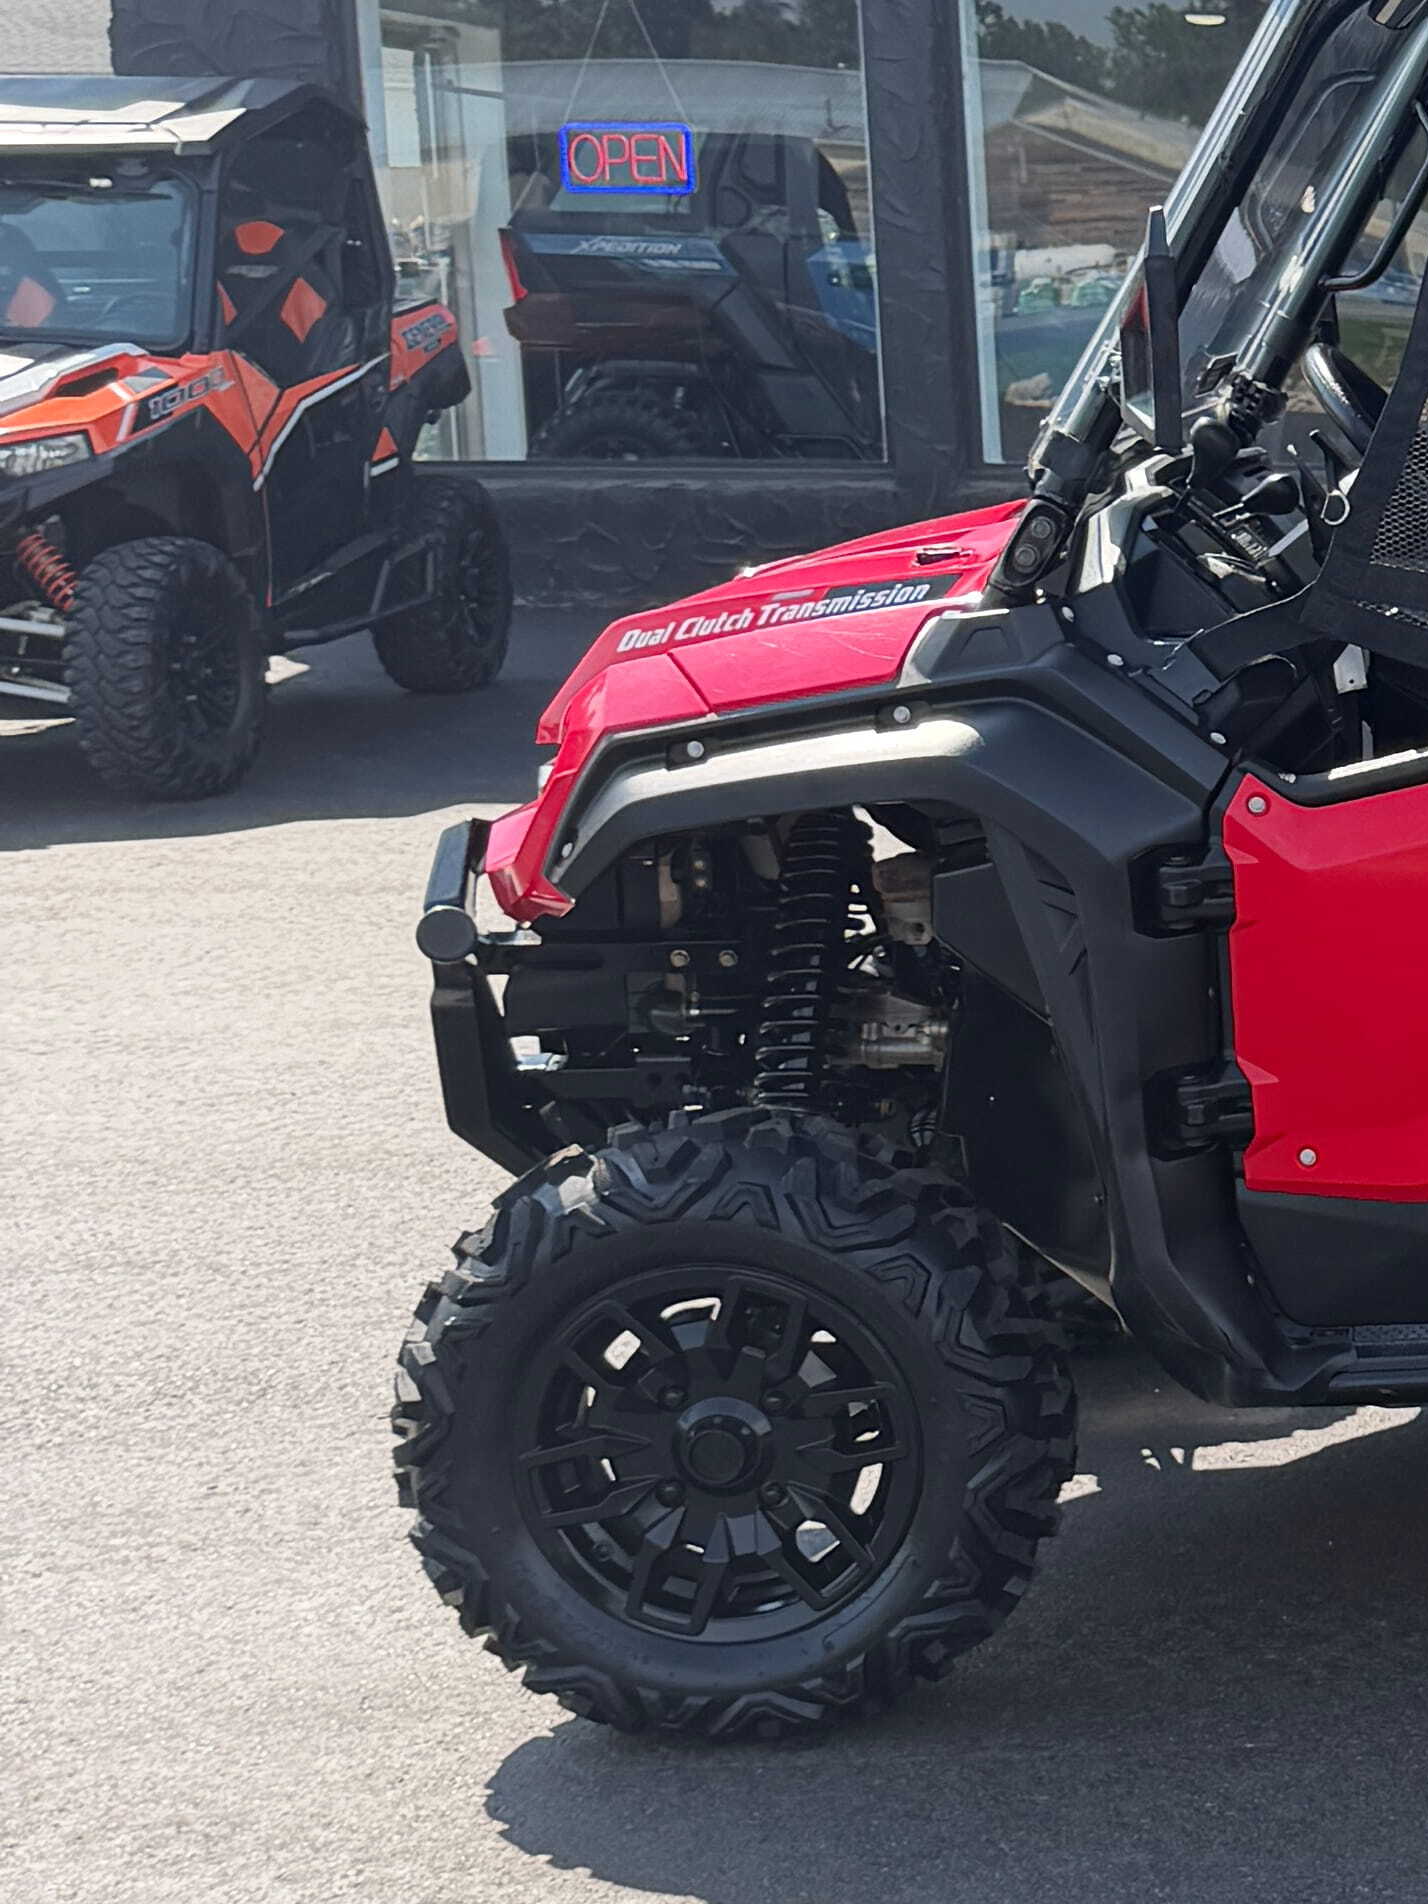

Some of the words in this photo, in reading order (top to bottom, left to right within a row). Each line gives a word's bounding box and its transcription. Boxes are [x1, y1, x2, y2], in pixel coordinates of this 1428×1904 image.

[568, 133, 688, 183] OPEN
[570, 237, 682, 255] XPEDITION
[617, 623, 672, 653] Dual
[675, 611, 754, 641] Clutch
[756, 584, 931, 628] Transmission
